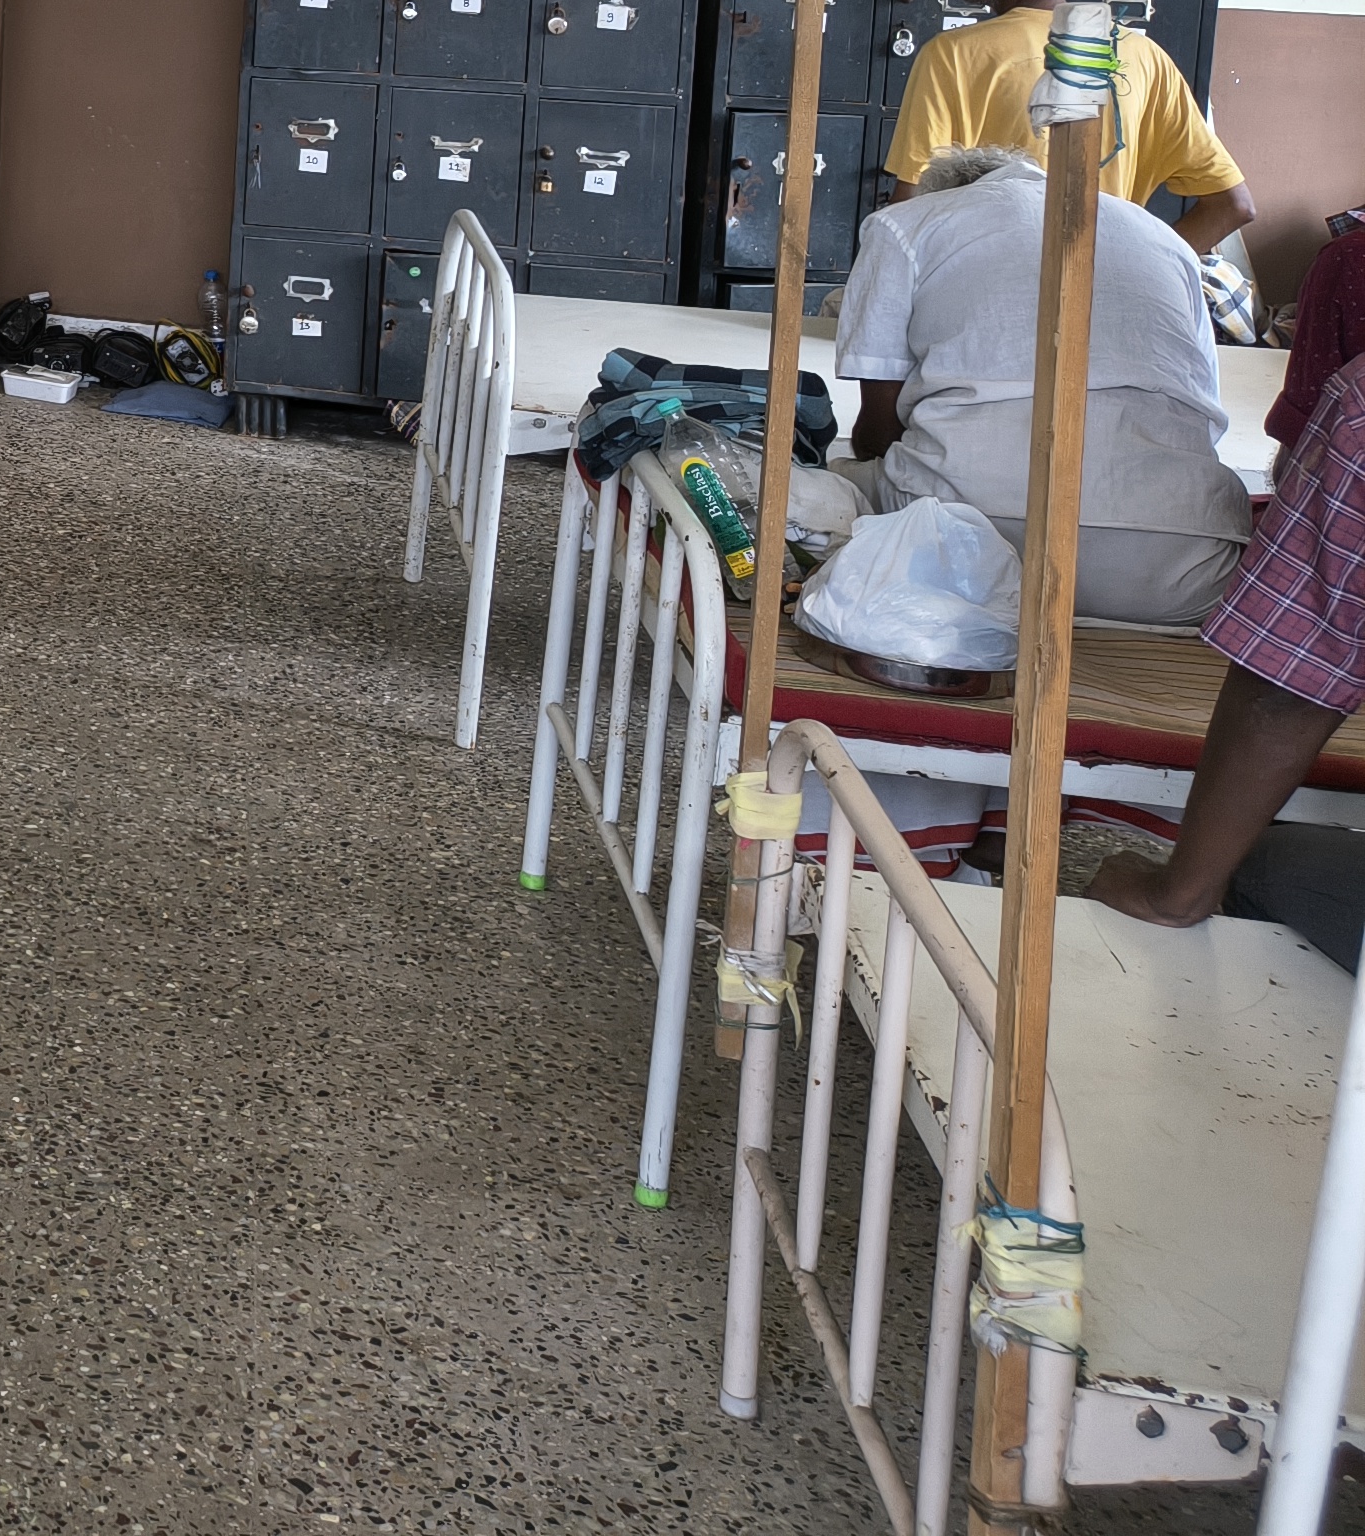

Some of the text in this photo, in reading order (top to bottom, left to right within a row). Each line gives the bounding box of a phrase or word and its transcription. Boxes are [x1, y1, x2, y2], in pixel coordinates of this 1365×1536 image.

[606, 12, 614, 23] 9
[305, 155, 319, 165] 10
[593, 176, 605, 186] 12
[298, 321, 311, 331] 13
